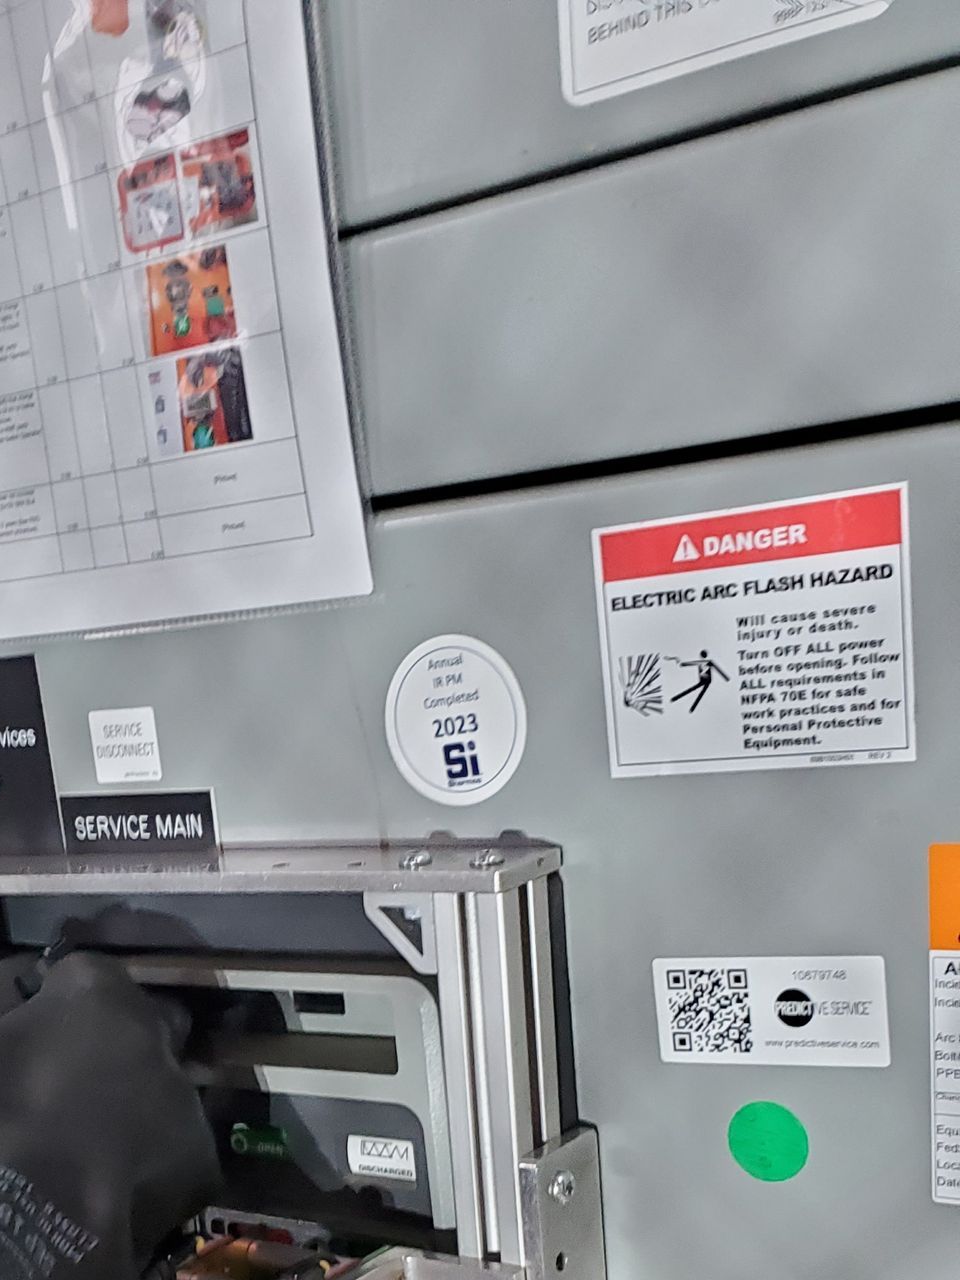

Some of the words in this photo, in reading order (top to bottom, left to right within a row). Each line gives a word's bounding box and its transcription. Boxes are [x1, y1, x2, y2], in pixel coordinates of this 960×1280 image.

[587, 10, 649, 45] BEHIND
[703, 523, 807, 556] DANGER
[611, 588, 696, 611] ELECTRIC
[700, 583, 738, 602] ARC
[743, 574, 804, 596] FLASH
[810, 563, 893, 588] HAZARD
[736, 614, 765, 628] Will
[770, 610, 817, 625] cause
[822, 604, 877, 619] severe
[737, 628, 782, 642] injury
[787, 625, 803, 636] or
[808, 619, 859, 634] death.
[737, 650, 769, 661] Turn
[773, 644, 802, 658] OFF
[806, 641, 835, 655] ALL
[838, 638, 886, 653] power
[427, 653, 464, 671] Annual
[738, 662, 782, 676] before
[786, 657, 849, 672] opening.
[852, 652, 901, 666] Follow
[445, 672, 463, 686] PM
[739, 679, 766, 691] ALL
[770, 671, 867, 689] requirements
[871, 668, 886, 680] in
[423, 688, 481, 710] Completed
[741, 691, 776, 706] NFPA
[780, 689, 807, 702] 70E
[811, 687, 832, 700] for
[835, 685, 867, 697] safe
[742, 707, 775, 720] work
[779, 703, 846, 719] practices
[849, 699, 876, 712] and
[880, 698, 902, 710] for
[103, 721, 143, 739] SERVICE
[431, 713, 479, 739] 2023
[743, 720, 803, 735] Personal
[807, 716, 883, 731] Protective
[96, 741, 155, 760] DISCONNECT
[743, 735, 823, 750] Equipment.
[74, 815, 150, 841] SERVICE
[155, 812, 203, 840] MAIN
[830, 1000, 871, 1016] SERVICE
[764, 1039, 880, 1050] www.predictiveservice.com
[358, 1163, 413, 1178] DISCHARGED
